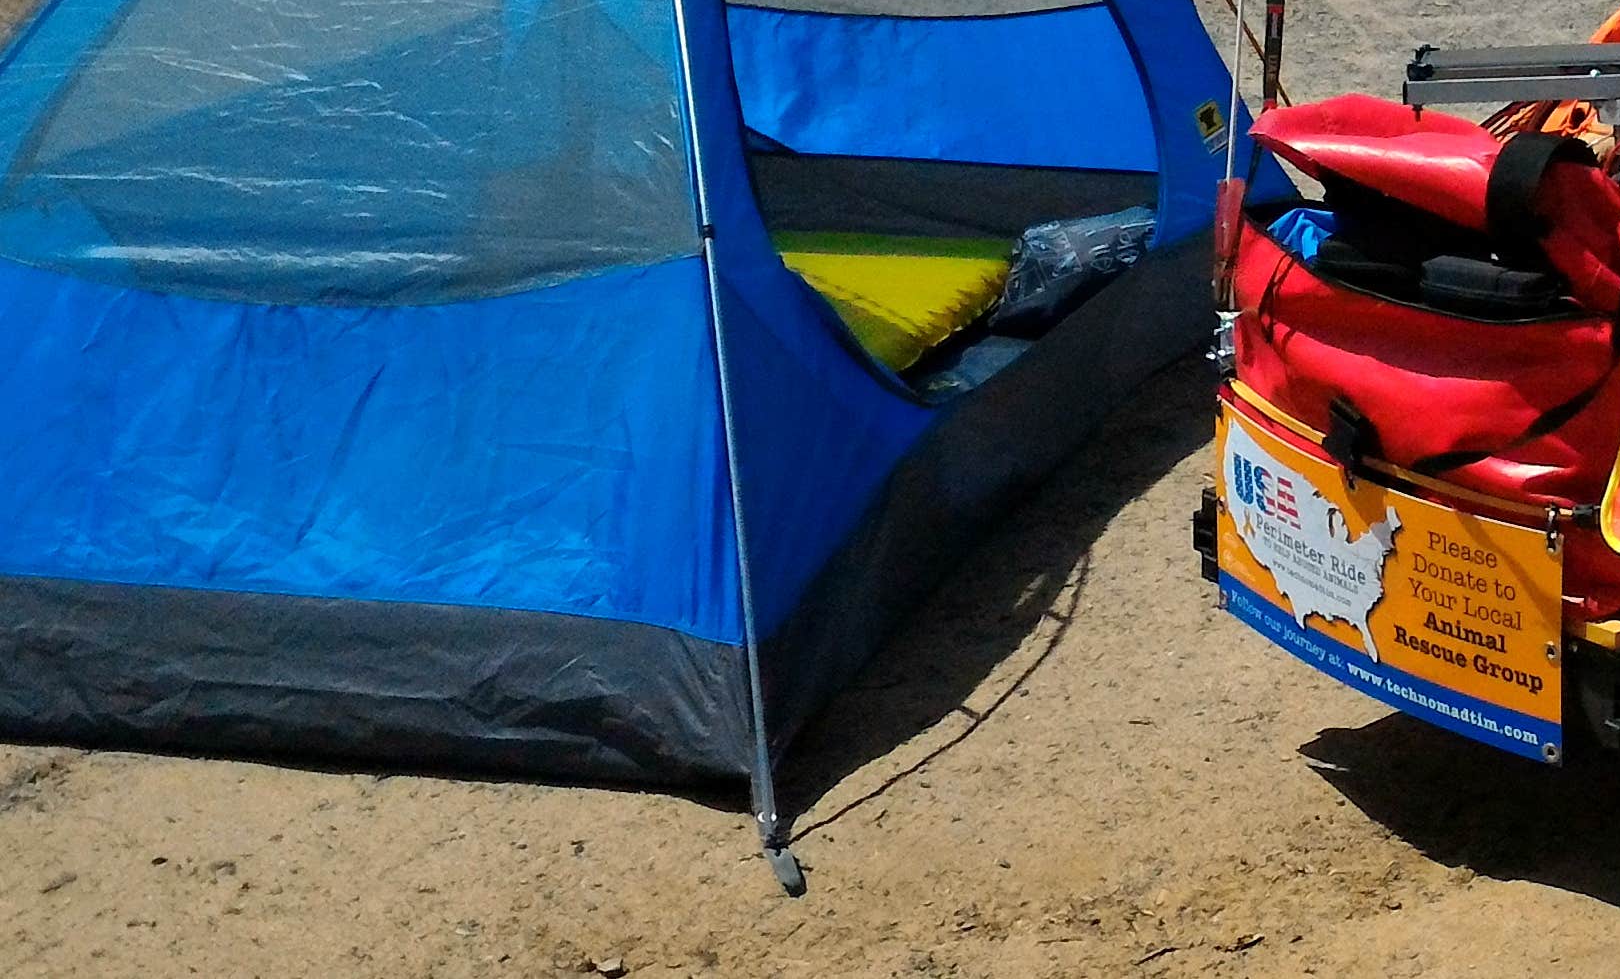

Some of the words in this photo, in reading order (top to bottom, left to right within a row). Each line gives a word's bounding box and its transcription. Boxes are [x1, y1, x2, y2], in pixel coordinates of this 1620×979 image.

[1233, 451, 1302, 531] USA
[1256, 513, 1326, 566] Perimeter
[1330, 554, 1367, 586] Ride
[1412, 552, 1487, 594] Donate
[1494, 579, 1516, 601] to
[1427, 531, 1498, 569] Please
[1408, 577, 1457, 611] Your
[1463, 596, 1523, 632] Local
[1424, 611, 1508, 654] Animal
[1231, 589, 1263, 620] Follow
[1264, 615, 1282, 633] our
[1283, 622, 1327, 662] journey
[1347, 662, 1540, 746] www.technomadtim.com
[1393, 624, 1468, 669] Rescue
[1473, 654, 1544, 695] Group
